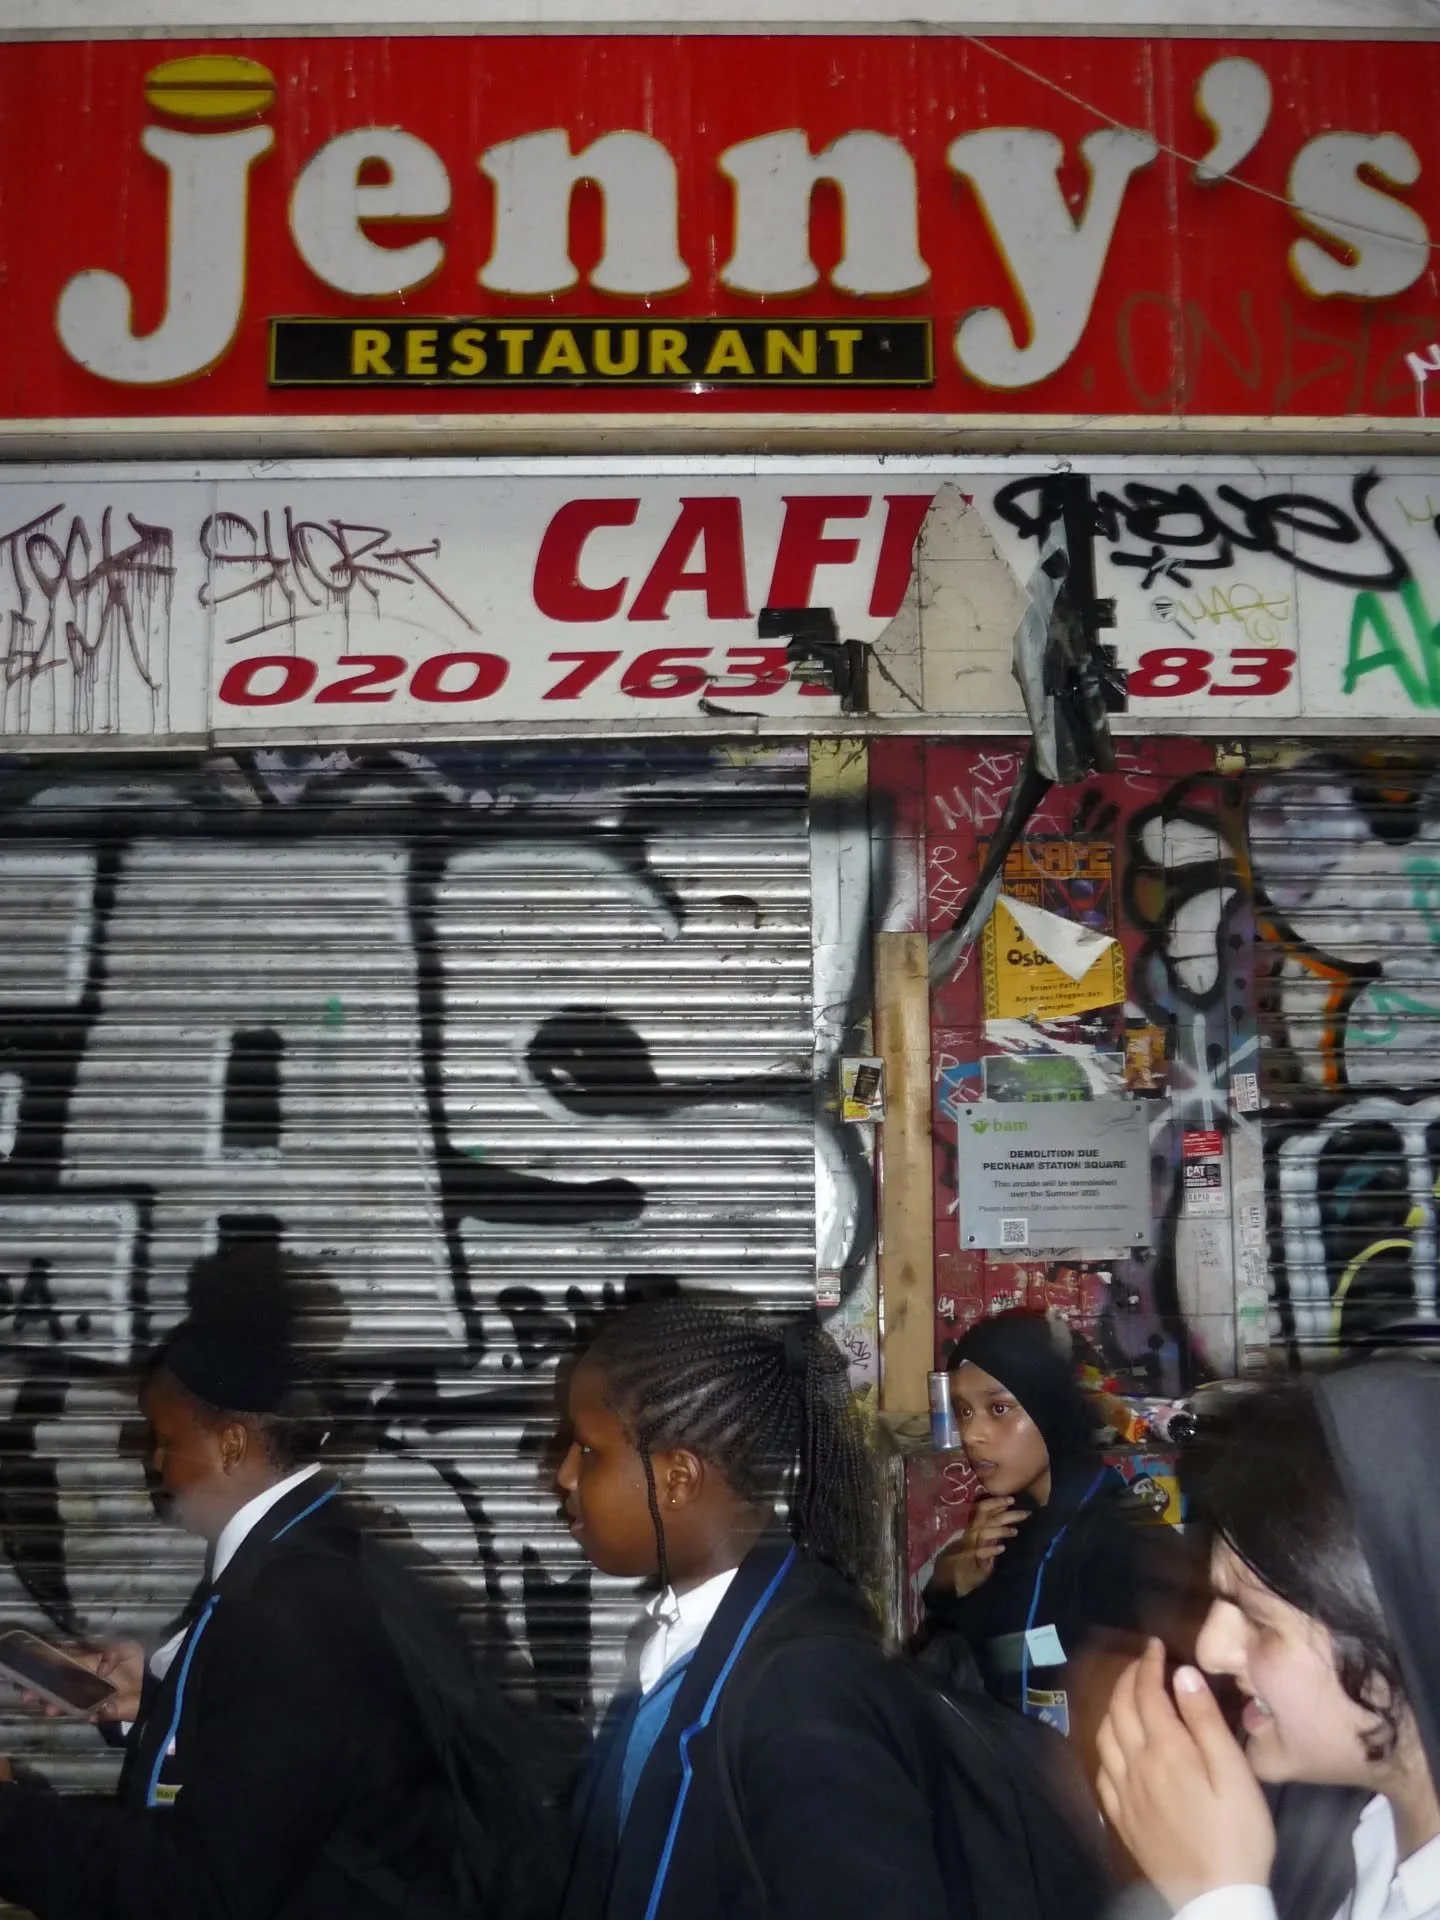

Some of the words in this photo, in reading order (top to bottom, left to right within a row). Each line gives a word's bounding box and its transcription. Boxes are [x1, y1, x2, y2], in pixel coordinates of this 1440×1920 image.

[56, 55, 1431, 388] jenny's
[351, 328, 863, 376] RESTAURANT
[218, 651, 512, 707] 020
[541, 646, 836, 700] 763
[993, 1118, 1029, 1132] bam
[983, 1162, 1035, 1171] PECKHAM
[1037, 1161, 1082, 1170] STATION
[1084, 1160, 1127, 1169] SQUARE
[1009, 1150, 1075, 1159] DEMOLITION
[1077, 1149, 1100, 1158] DUE
